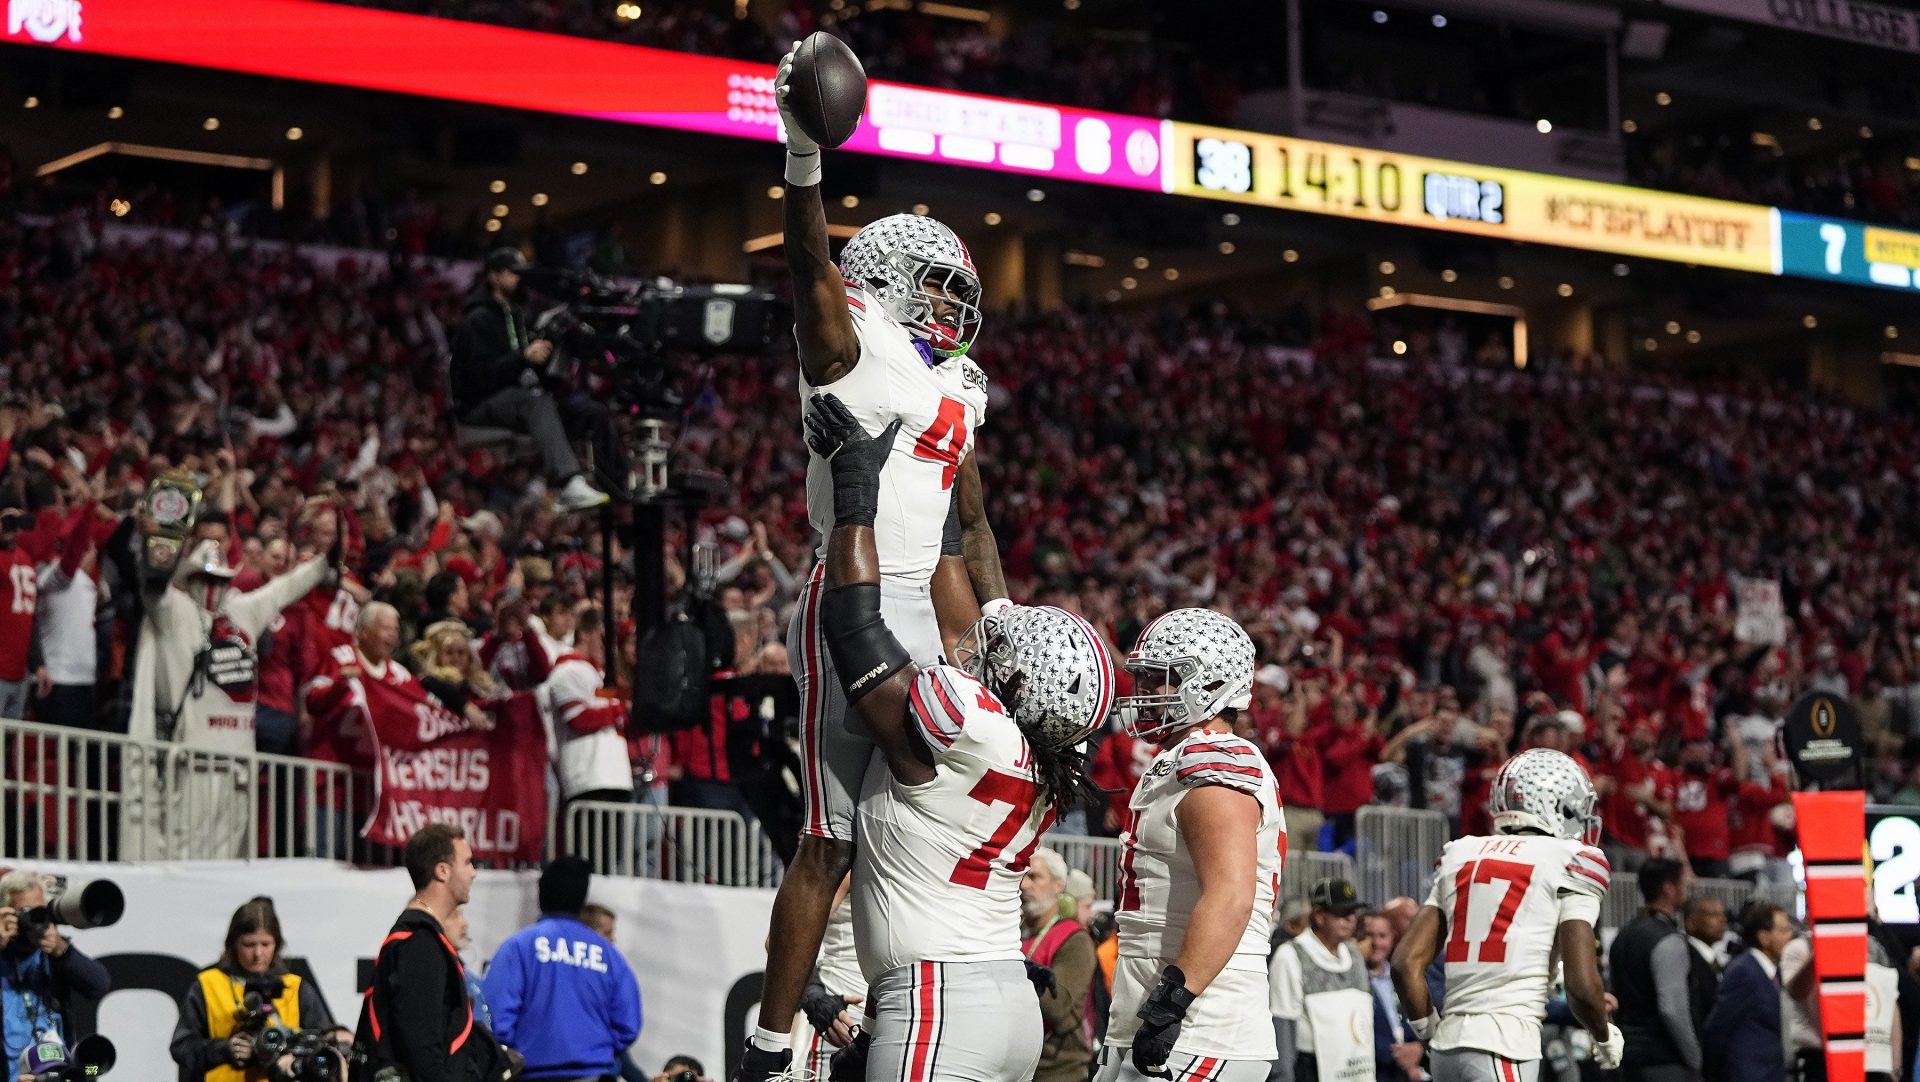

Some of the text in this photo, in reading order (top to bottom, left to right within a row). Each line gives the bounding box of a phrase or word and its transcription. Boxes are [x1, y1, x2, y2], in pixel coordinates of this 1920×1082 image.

[1278, 147, 1401, 212] 14:10
[1820, 223, 1847, 275] 7
[912, 395, 968, 491] 4
[382, 745, 490, 792] VERSUS
[1479, 840, 1527, 856] TATE
[1870, 815, 1920, 924] 2
[1444, 858, 1535, 964] 17
